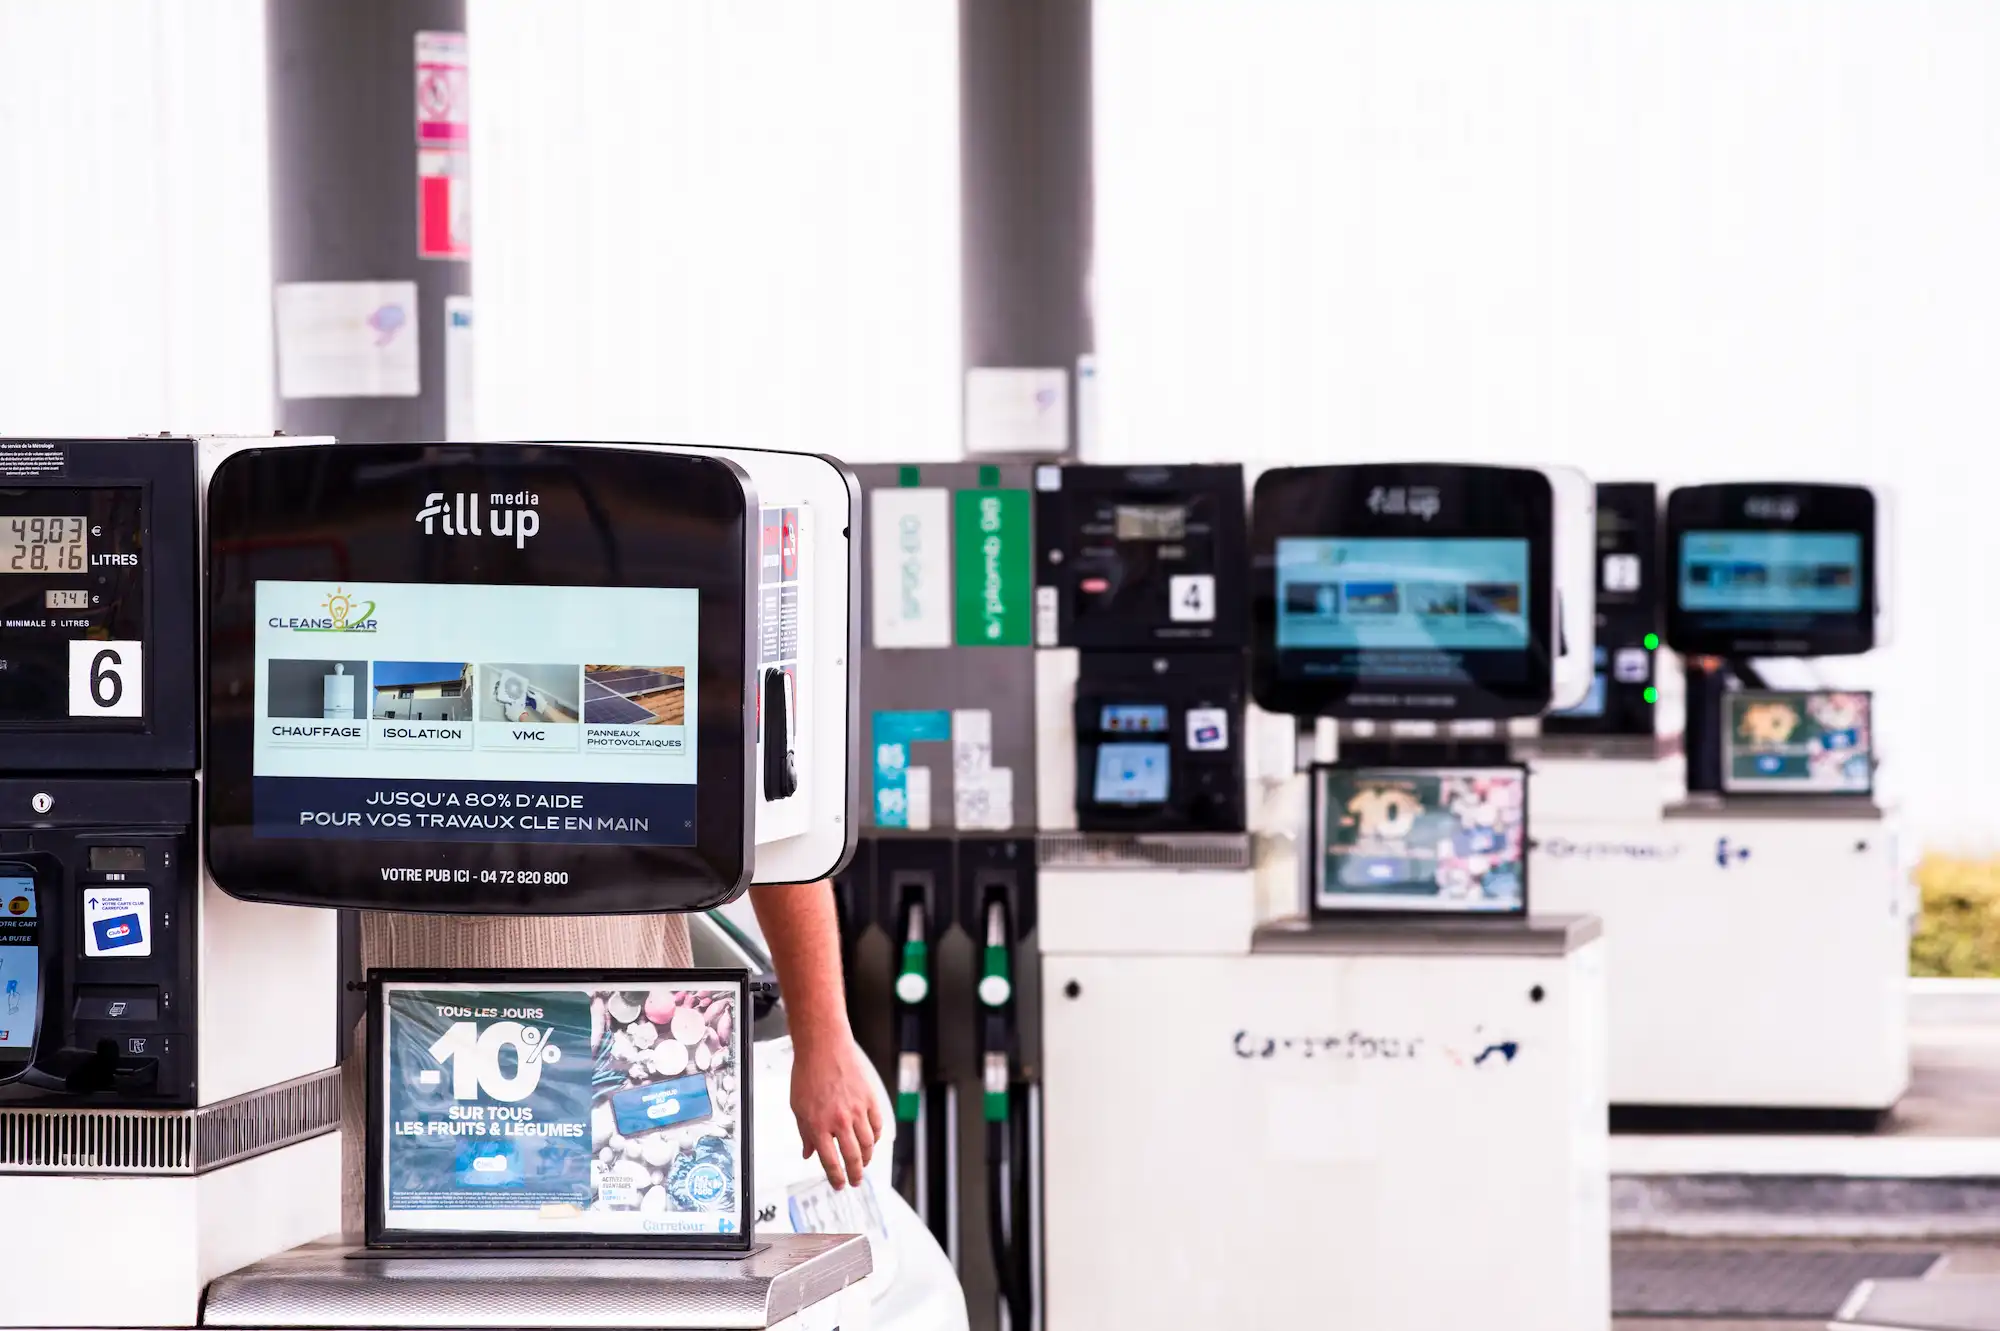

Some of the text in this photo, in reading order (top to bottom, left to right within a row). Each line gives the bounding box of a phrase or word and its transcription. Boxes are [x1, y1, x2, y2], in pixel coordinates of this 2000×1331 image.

[490, 491, 539, 505] media
[415, 492, 540, 549] fill up
[11, 518, 102, 545] 49,03 €
[11, 545, 138, 571] 28,16 LITRES
[53, 592, 100, 606] 1,741 €
[1183, 583, 1202, 611] 4
[90, 649, 123, 708] 6
[271, 726, 361, 737] CHAUFFAGE
[383, 728, 462, 739] ISOLATION
[512, 731, 545, 741] VMC
[587, 738, 682, 748] PHOTOVOLTAIQUES
[366, 791, 584, 809] JUSQU'A 80% D'AIDE
[299, 811, 649, 831] POUR VOS TRAVAUX CLE EN MAIN
[380, 868, 423, 882] VOTRE
[425, 868, 451, 882] PUB
[454, 869, 470, 882] ICI
[480, 870, 497, 883] 04
[499, 870, 515, 884] 72
[517, 871, 541, 884] 820
[543, 871, 569, 885] 800
[436, 1006, 544, 1019] TOUS LES JOURS
[420, 1021, 562, 1102] -10%
[448, 1106, 533, 1121] SUR TOUS
[395, 1121, 424, 1136] LES
[427, 1121, 486, 1136] FRUITS
[489, 1122, 501, 1136] &
[642, 1220, 706, 1232] Carrefour
